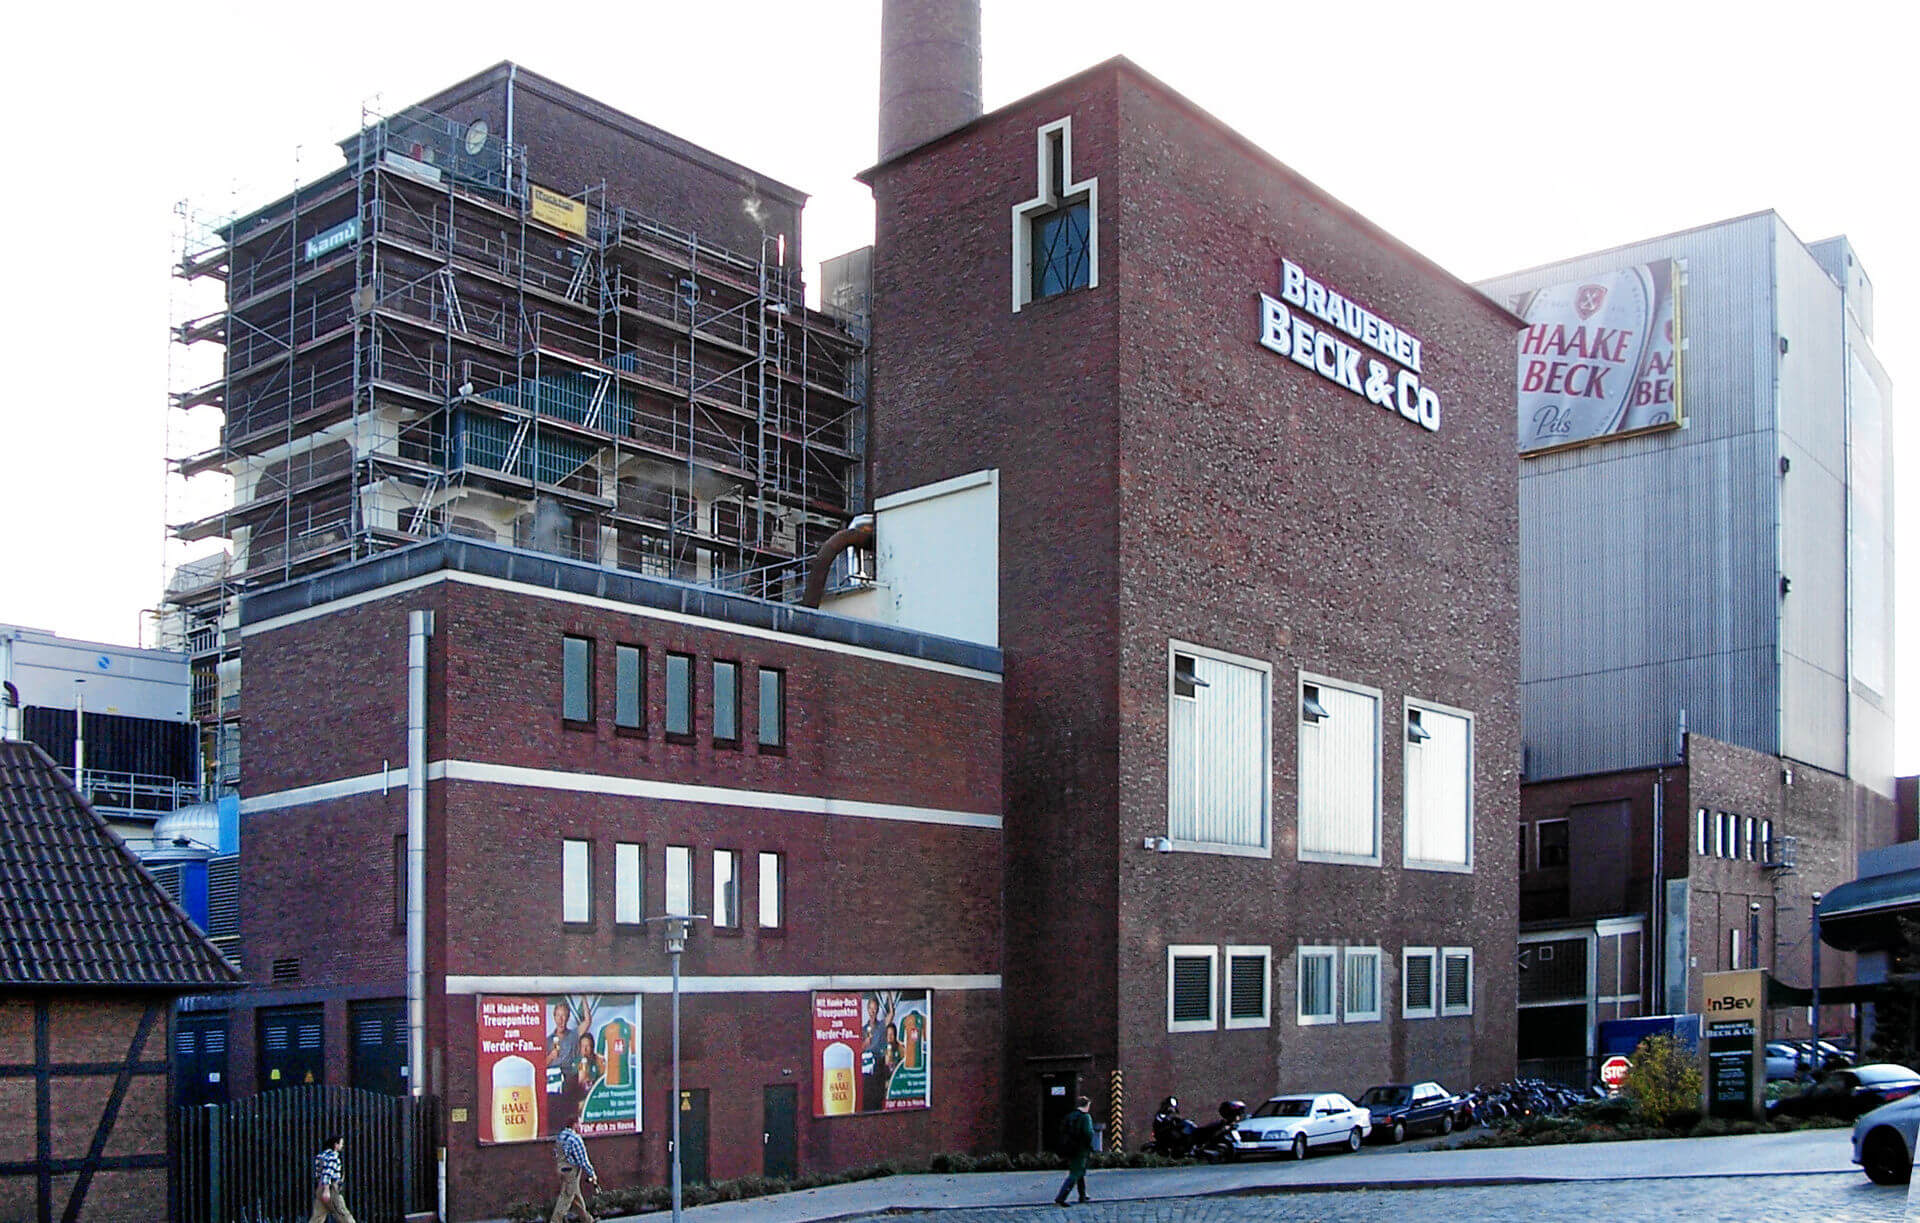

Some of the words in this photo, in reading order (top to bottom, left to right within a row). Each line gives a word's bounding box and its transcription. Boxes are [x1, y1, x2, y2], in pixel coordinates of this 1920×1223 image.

[1281, 257, 1422, 374] BRAUEREI
[1259, 291, 1364, 396] BECK
[1365, 359, 1395, 411] &
[1397, 369, 1441, 433] CO
[1521, 323, 1633, 364] HAAKE
[1521, 360, 1611, 400] BECK
[1532, 404, 1571, 436] Pils
[483, 1014, 540, 1028] Treuepunkten
